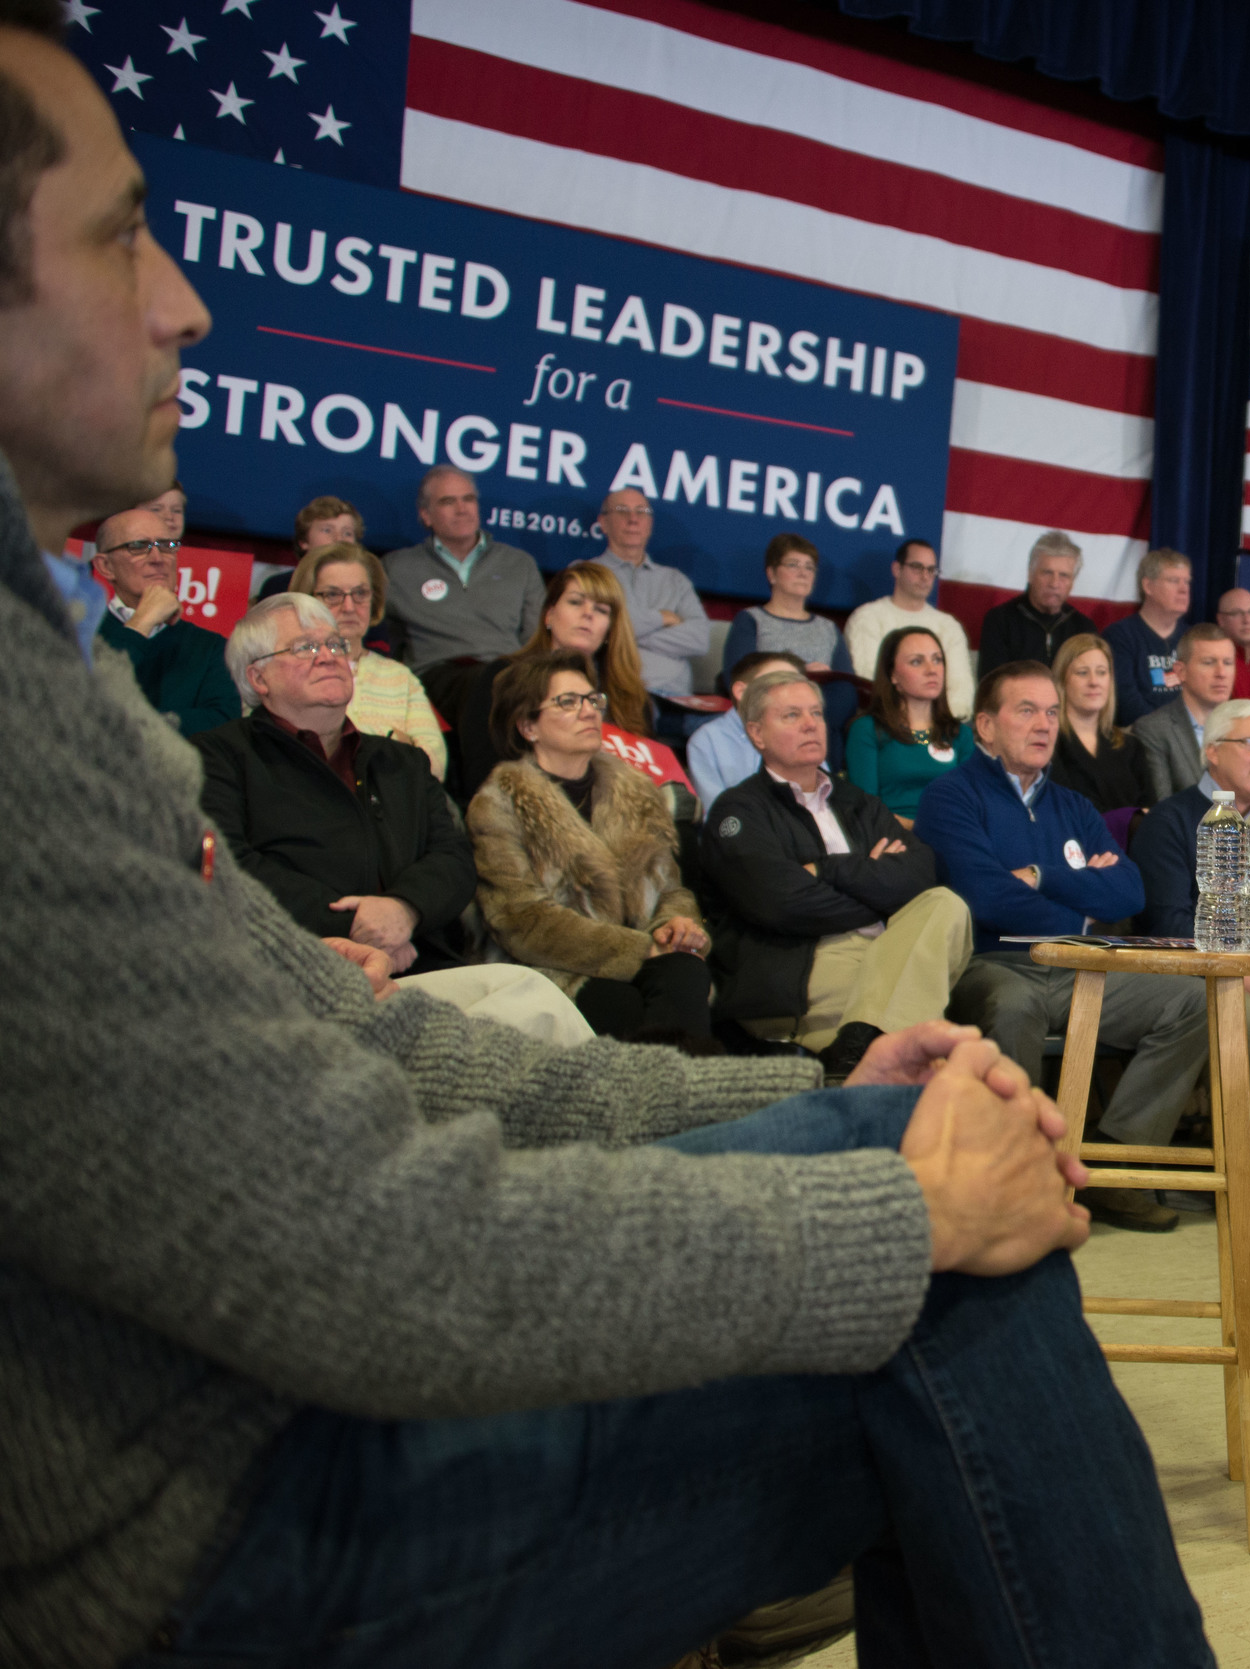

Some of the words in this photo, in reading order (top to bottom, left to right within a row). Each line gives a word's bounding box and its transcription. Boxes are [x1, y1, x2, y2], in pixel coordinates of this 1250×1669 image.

[174, 199, 510, 320] TRUSTED
[536, 276, 926, 401] LEADERSHIP
[523, 353, 597, 406] for
[604, 377, 632, 411] a
[176, 367, 588, 489] STRONGER
[609, 442, 905, 536] AMERICA
[486, 506, 604, 540] JEB2016.C
[178, 566, 222, 618] b!
